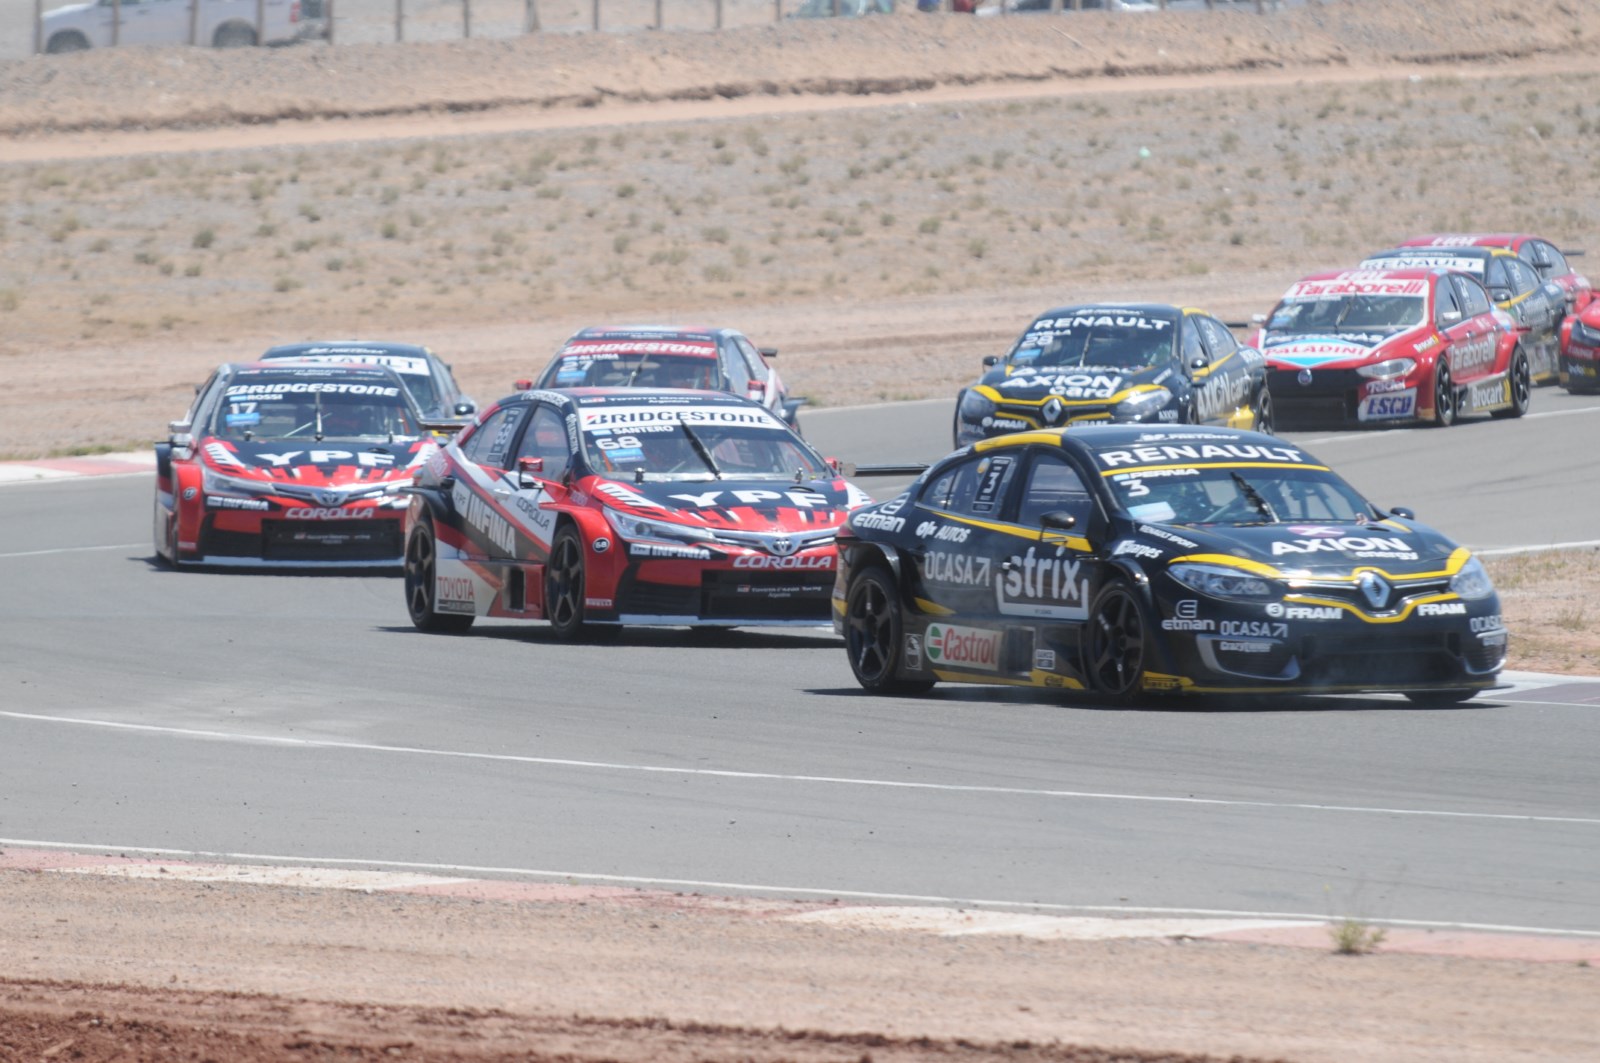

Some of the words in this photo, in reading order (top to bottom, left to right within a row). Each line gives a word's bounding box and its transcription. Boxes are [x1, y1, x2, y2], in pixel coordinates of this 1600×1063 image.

[1294, 280, 1425, 296] Taraborelli
[1033, 315, 1171, 331] RENAULT
[564, 341, 716, 356] BRIDGESTONE
[1021, 335, 1054, 349] 28
[1264, 343, 1366, 357] PALADINI
[559, 359, 594, 372] 27
[1000, 374, 1123, 389] AXION
[225, 383, 400, 397] BRIDGESTONE
[1048, 386, 1116, 399] card
[1471, 382, 1505, 408] Brocart
[230, 402, 258, 415] 17
[586, 409, 771, 426] BRIDGESTONE
[612, 425, 675, 436] SANTERO
[595, 435, 643, 451] 68
[255, 449, 396, 466] YPF
[1099, 444, 1304, 467] RENAULT
[1131, 467, 1200, 479] PERNIA
[982, 472, 1001, 494] 3
[1119, 479, 1150, 498] 3
[669, 489, 828, 508] YPF
[285, 507, 374, 520] COROLLA
[516, 496, 550, 531] COROLLA
[466, 493, 517, 560] INFINIA
[651, 545, 712, 560] INFINIA
[1271, 537, 1413, 556] AXION
[733, 554, 832, 569] COROLLA
[924, 550, 974, 585] OCASA
[1004, 545, 1081, 601] strix
[437, 575, 475, 600] TOYOTA
[1285, 607, 1343, 620] FRAM
[1417, 603, 1467, 617] FRAM
[1220, 621, 1272, 637] OCASA
[943, 627, 998, 666] Castrol
